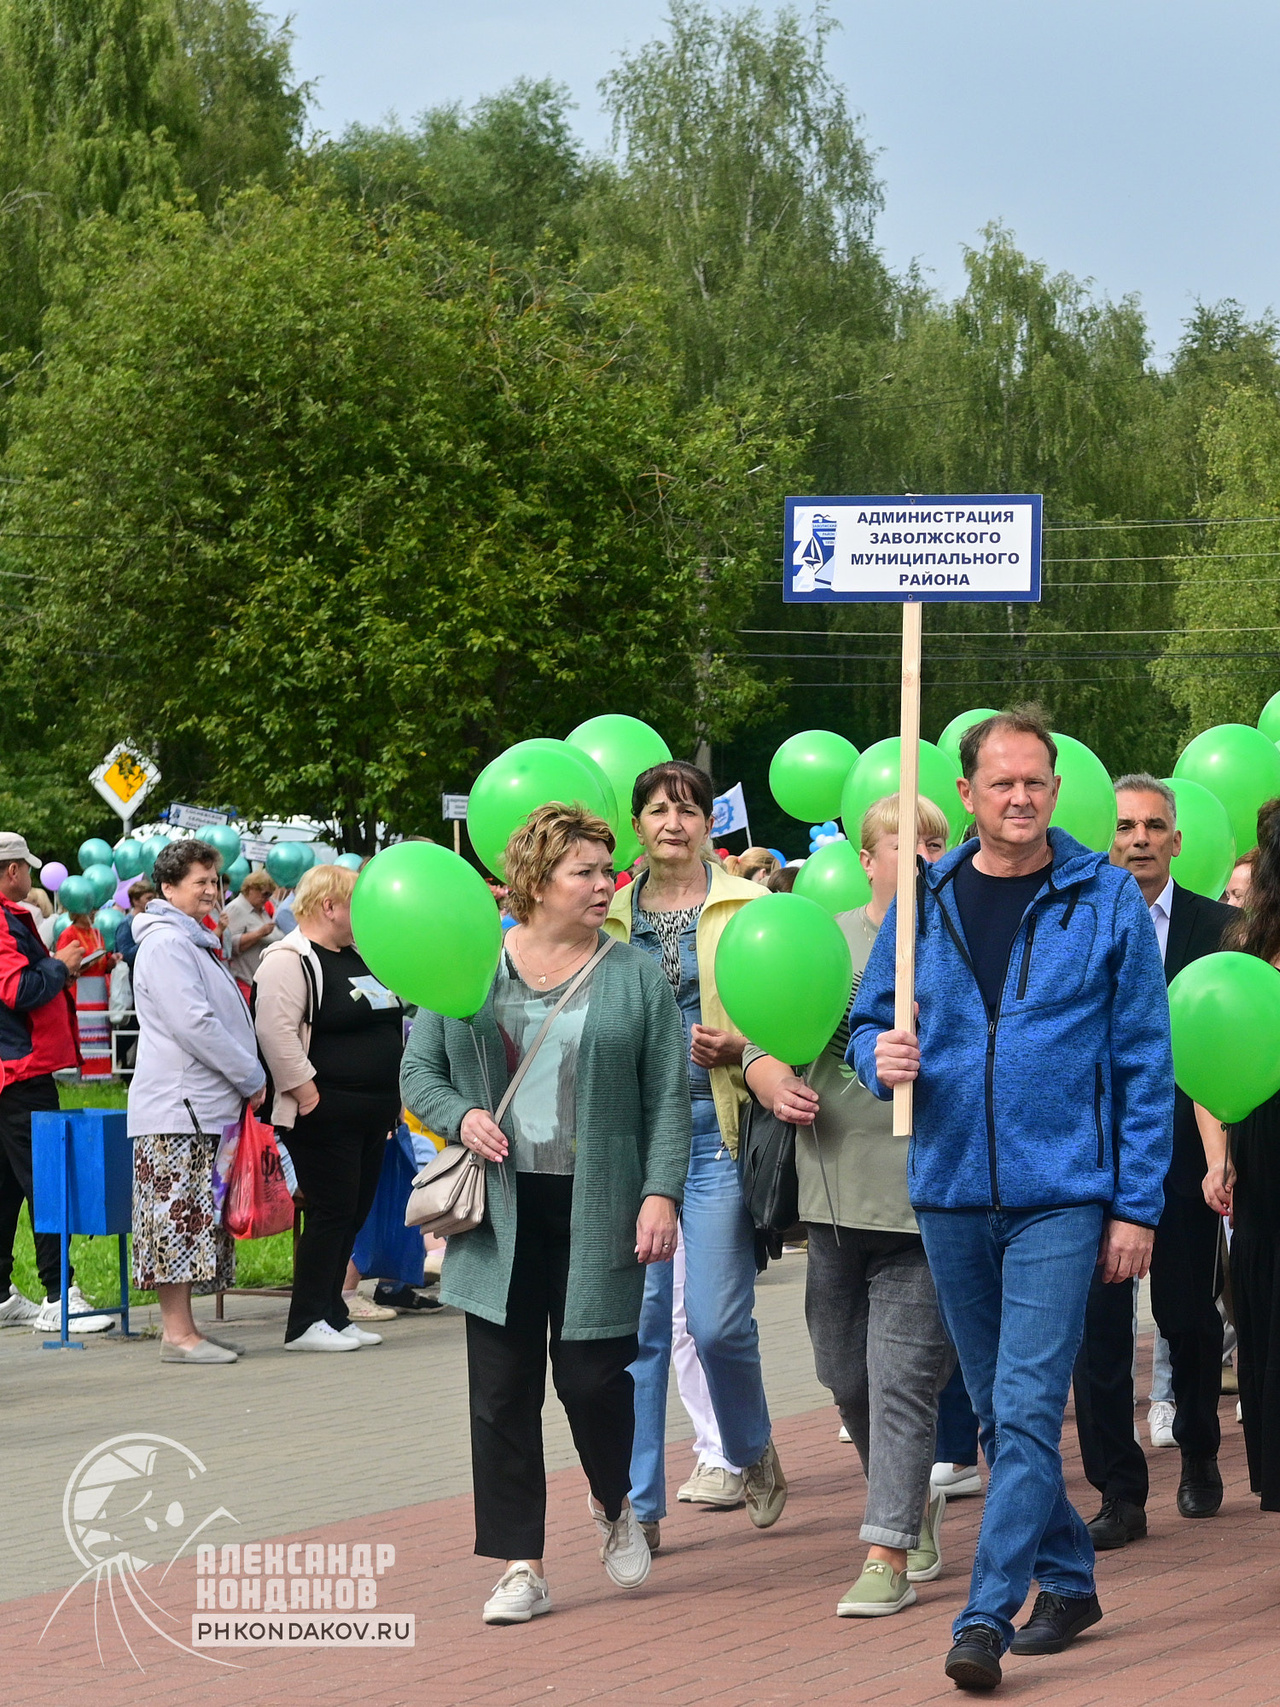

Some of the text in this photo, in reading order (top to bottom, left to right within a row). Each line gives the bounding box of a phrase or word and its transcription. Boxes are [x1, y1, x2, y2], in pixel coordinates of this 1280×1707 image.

[857, 511, 1014, 525] АДМИНИСТРАЦИЯ
[870, 532, 1001, 544] ЗАВОЛЖСКОГО
[851, 552, 1020, 567] МУНИЦИПАЛЬНОГО
[899, 571, 970, 586] РАЙОНА
